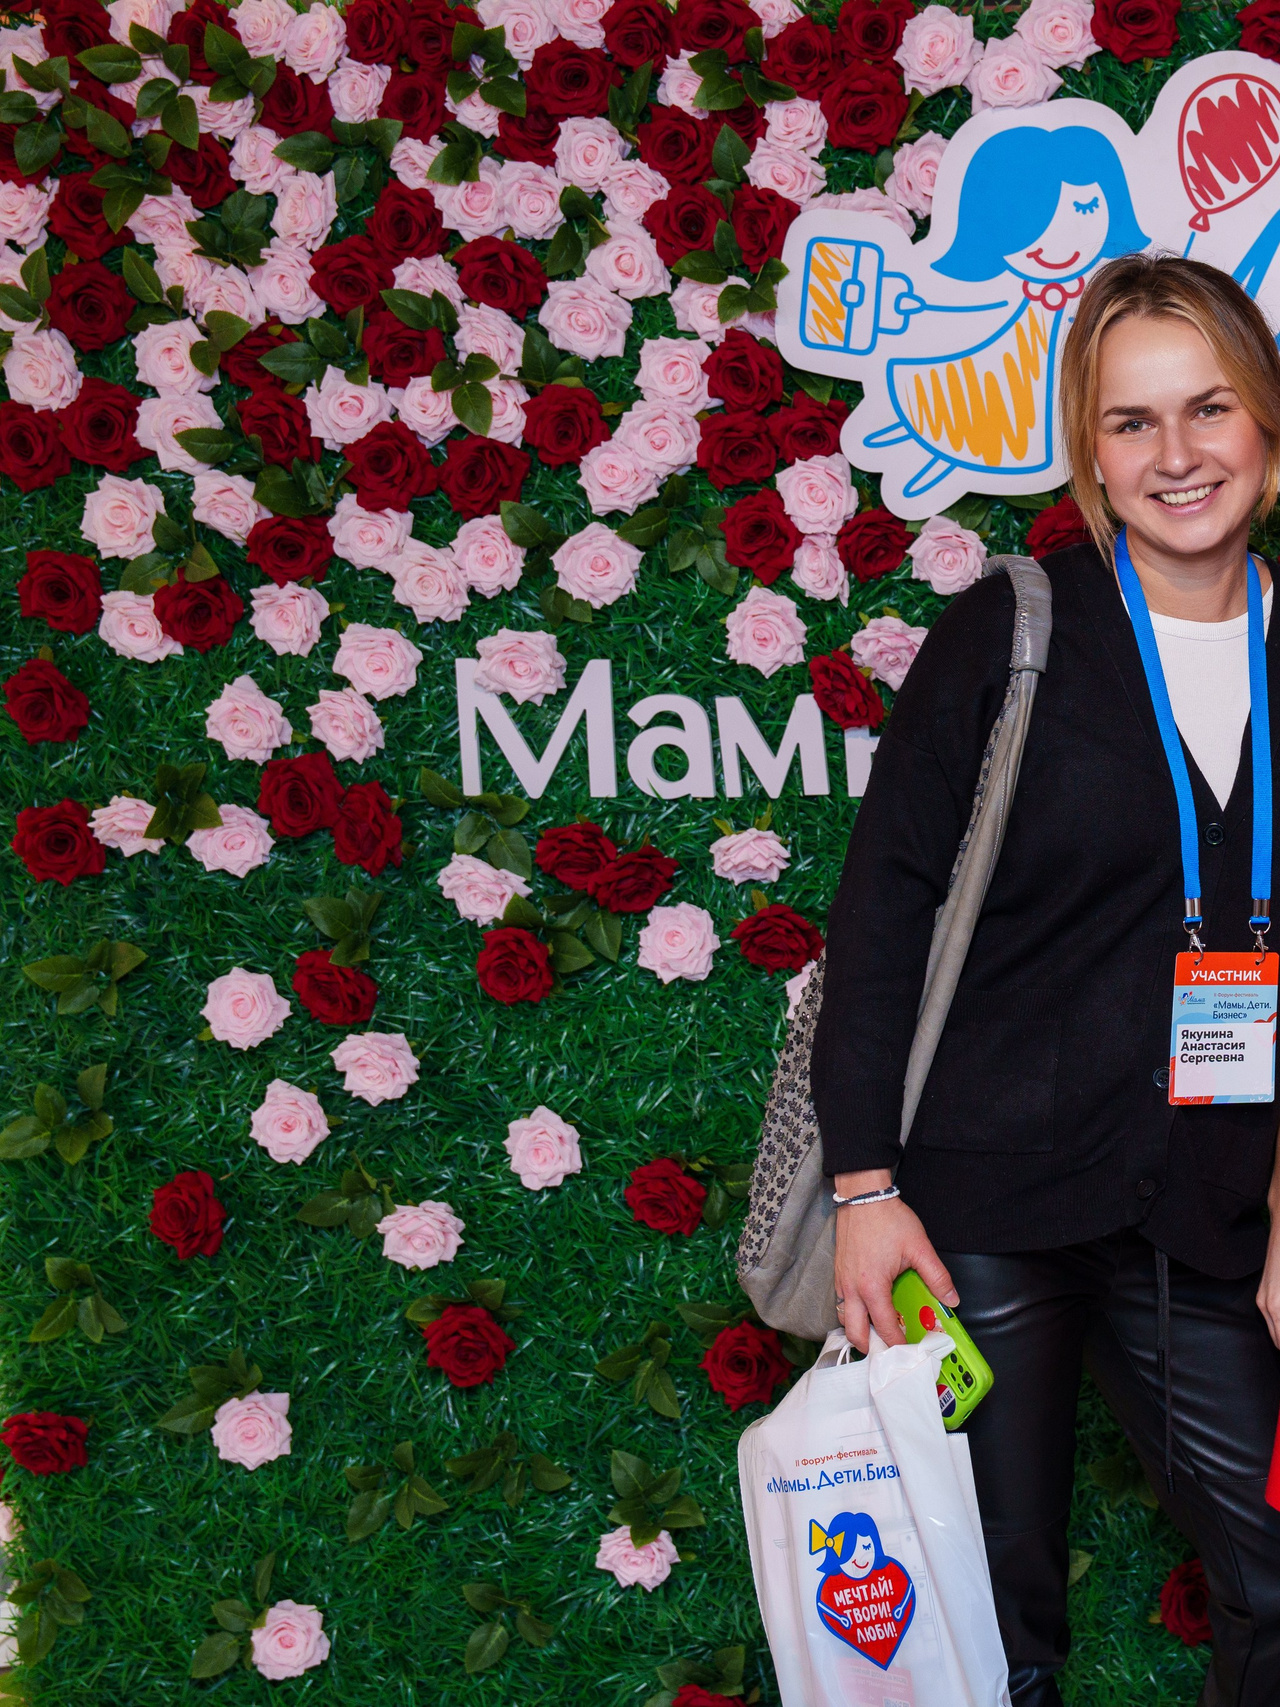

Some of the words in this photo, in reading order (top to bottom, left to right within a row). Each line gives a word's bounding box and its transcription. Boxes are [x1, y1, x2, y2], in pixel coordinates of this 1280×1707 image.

[1190, 970, 1262, 982] УЧАСТНИК
[1212, 1010, 1248, 1020] Бизнес»
[1181, 1029, 1234, 1042] Якунина
[1180, 1041, 1246, 1052] Анастасия
[1180, 1053, 1245, 1065] Сергеевна
[800, 1447, 878, 1466] Форум-фестиваль
[833, 1575, 895, 1607] МЕЧТАЙ!
[843, 1600, 893, 1625] ТВОРИ!
[856, 1623, 898, 1644] ЛЮБИ!
